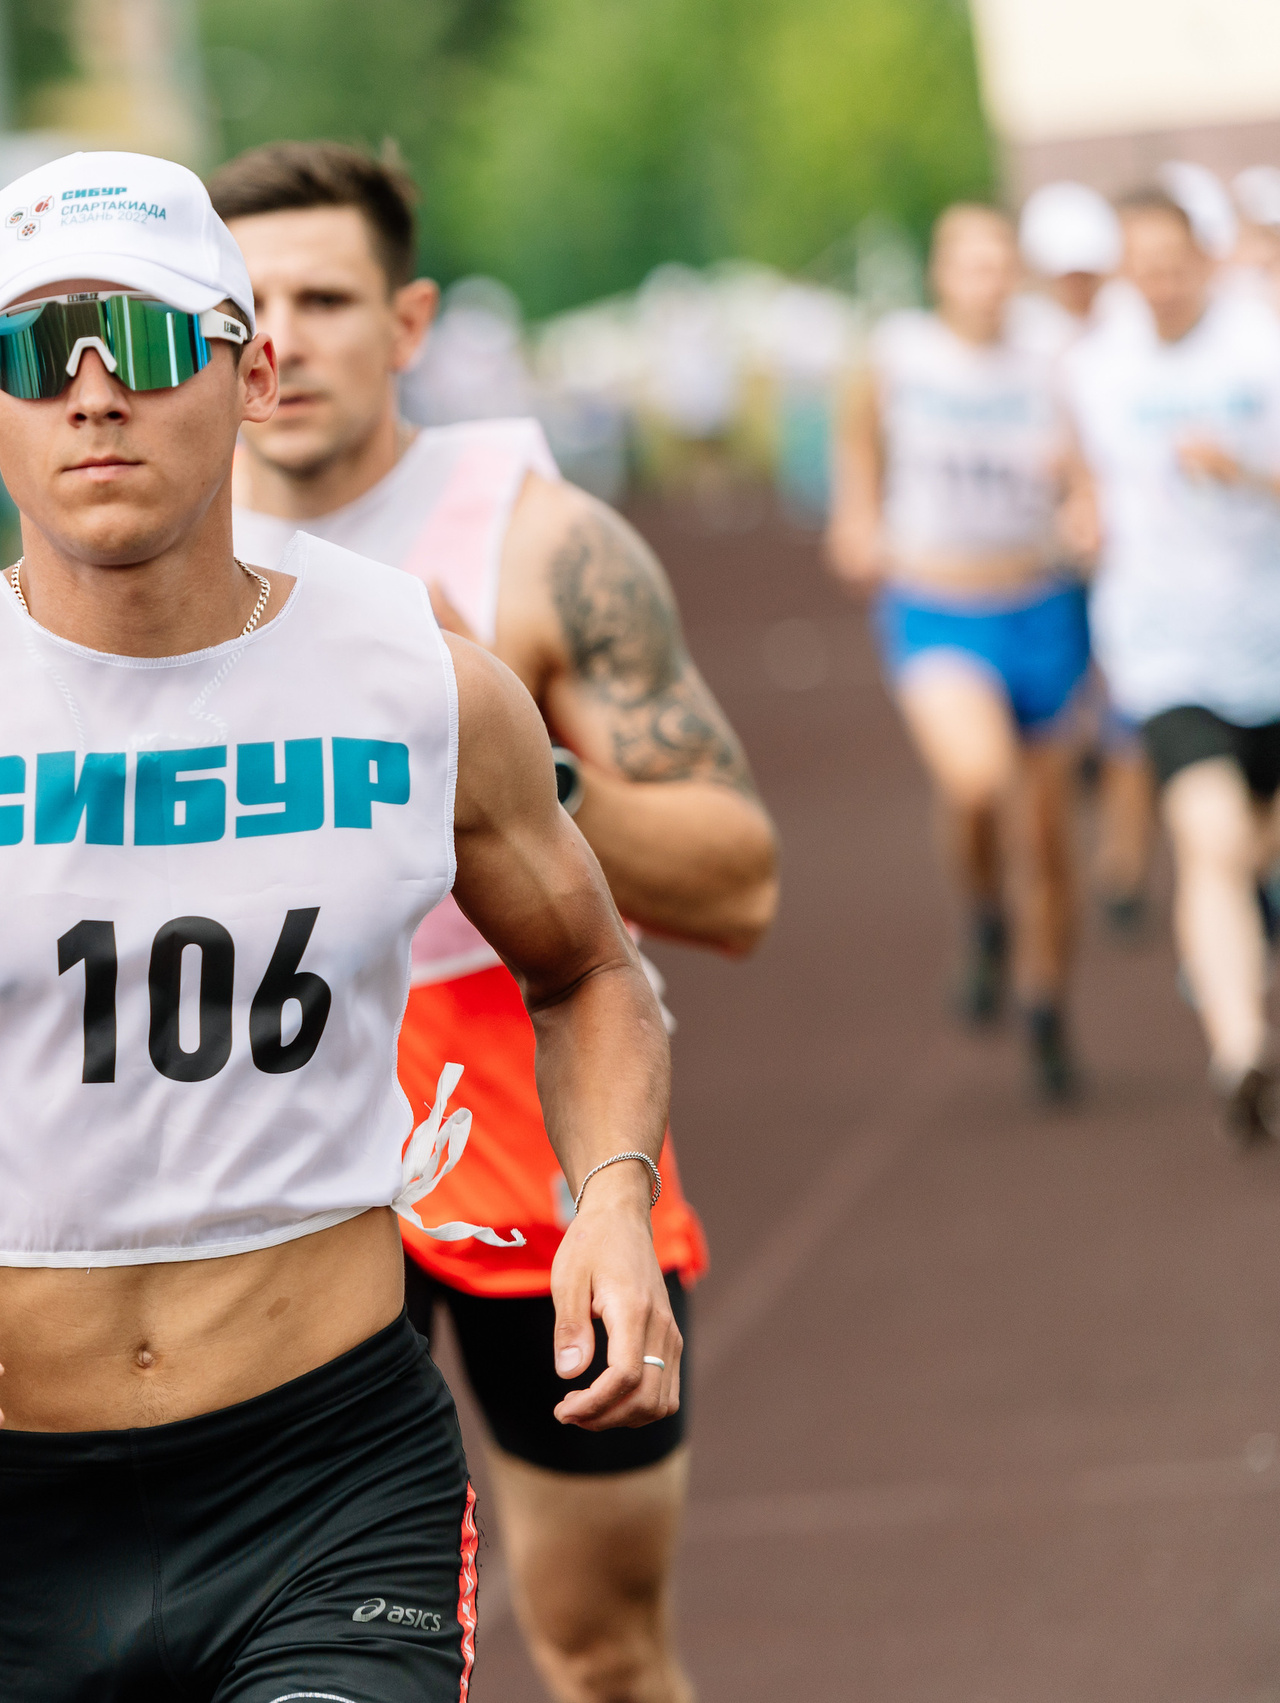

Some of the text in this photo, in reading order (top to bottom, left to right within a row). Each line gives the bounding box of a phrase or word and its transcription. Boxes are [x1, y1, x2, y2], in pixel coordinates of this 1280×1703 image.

[61, 187, 127, 201] СИБУР
[60, 210, 149, 226] КАЗАНЬ 2022
[61, 200, 167, 220] СПАРТАКИАДА
[57, 907, 332, 1084] 106
[387, 1606, 441, 1632] asics
